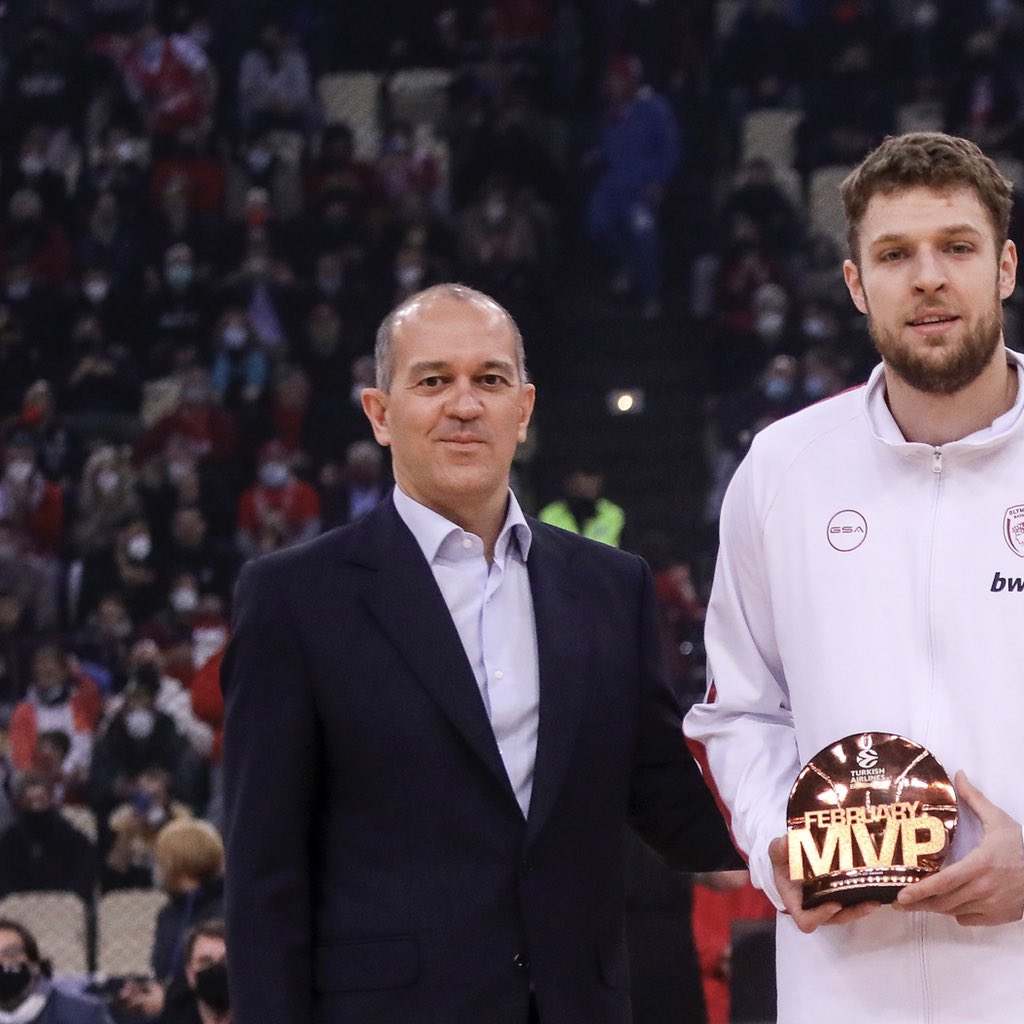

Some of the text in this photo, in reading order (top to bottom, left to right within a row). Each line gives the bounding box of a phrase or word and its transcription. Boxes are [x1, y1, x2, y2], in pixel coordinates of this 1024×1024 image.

[850, 768, 885, 777] TURKISH
[850, 775, 886, 783] AIRLINES
[804, 801, 920, 829] FEBRUARY
[787, 813, 946, 881] MVP
